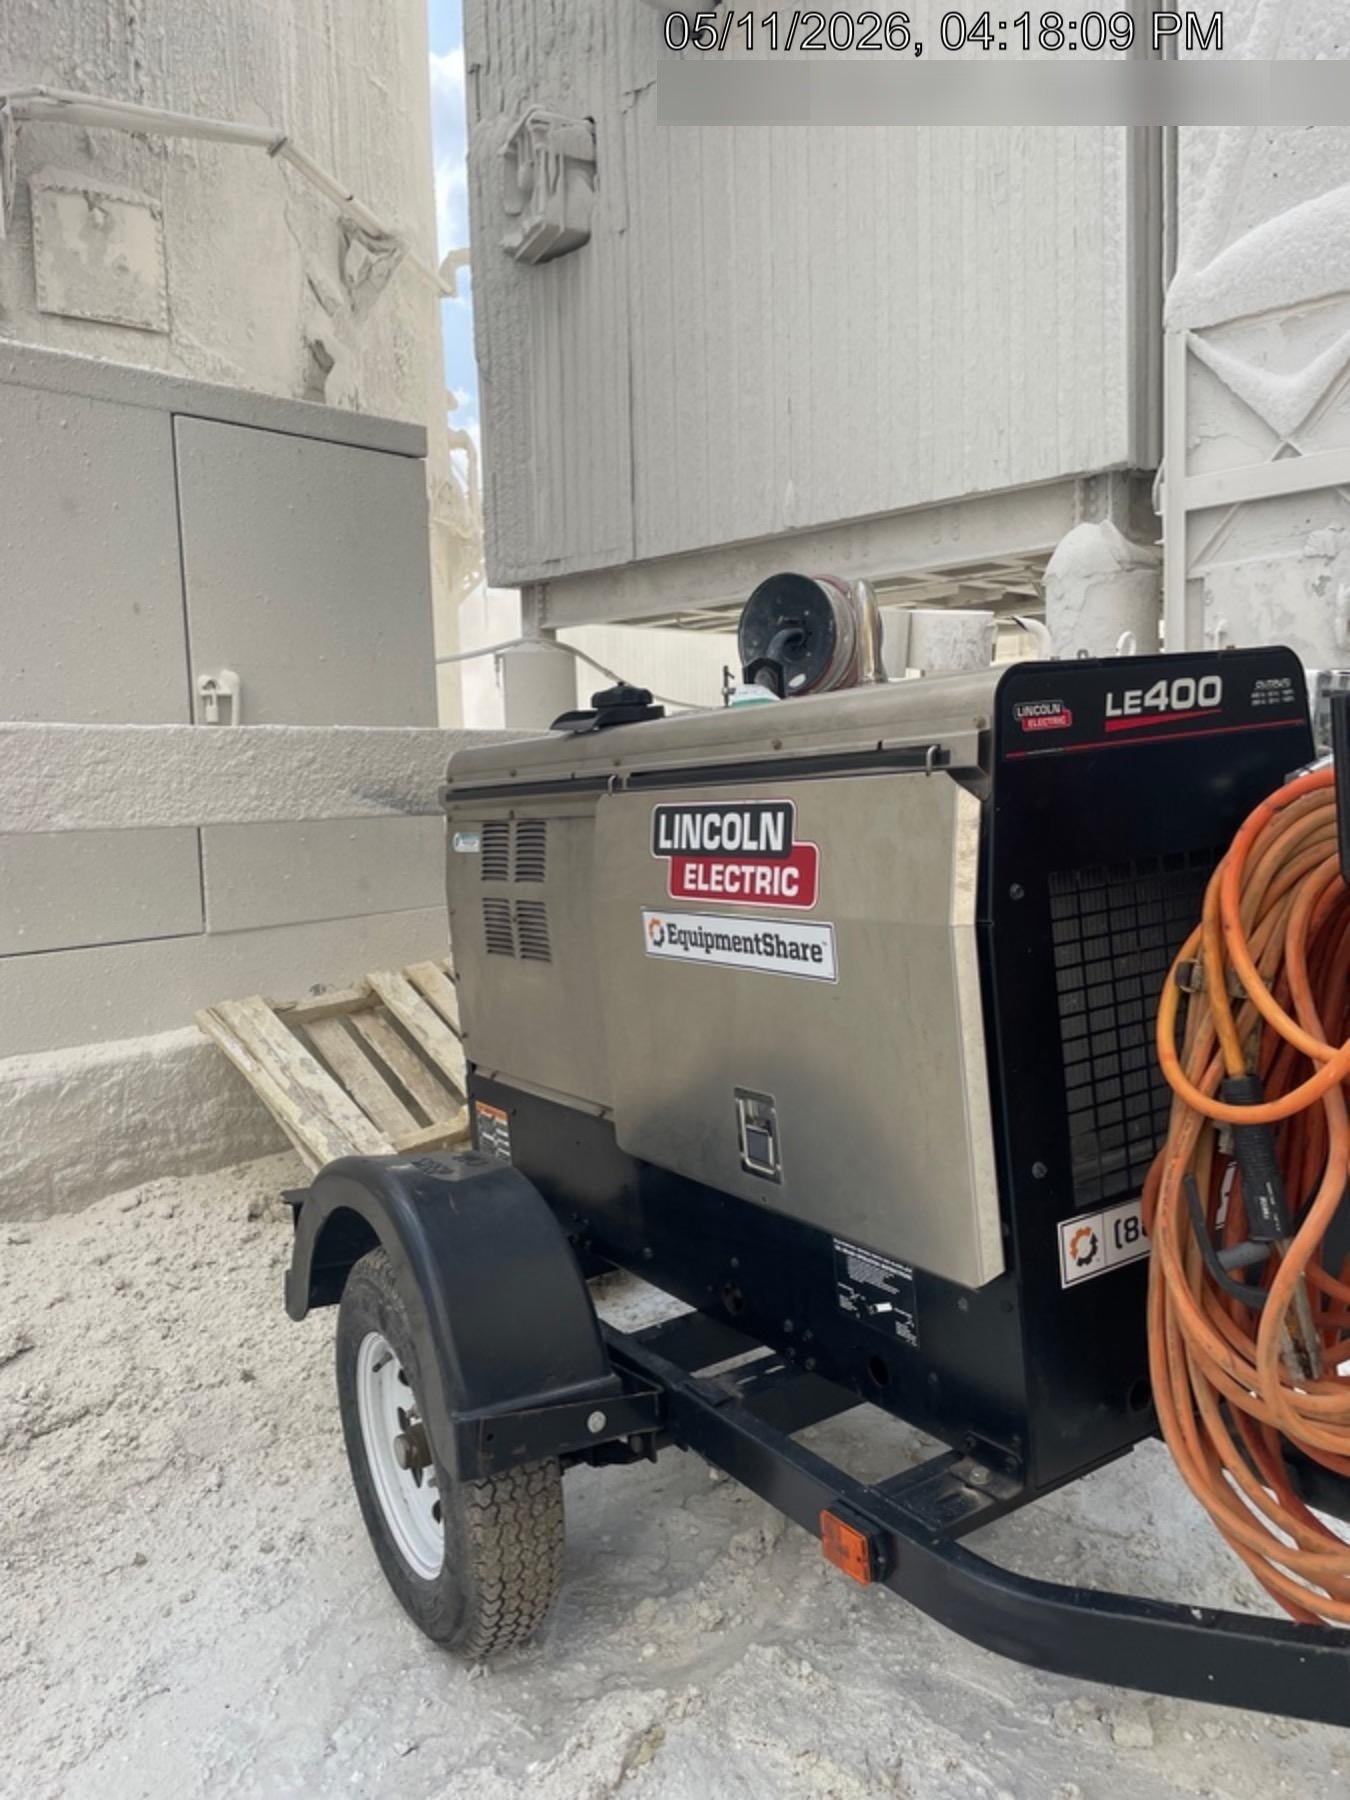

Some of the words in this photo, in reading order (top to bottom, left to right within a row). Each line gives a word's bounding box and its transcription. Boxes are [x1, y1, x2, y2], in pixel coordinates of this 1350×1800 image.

[1017, 703, 1061, 717] LINCOLN
[1105, 675, 1222, 717] LE400
[658, 811, 785, 851] LINCOLN
[683, 863, 799, 897] ELECTRIC
[666, 923, 824, 963] EquipmentShare
